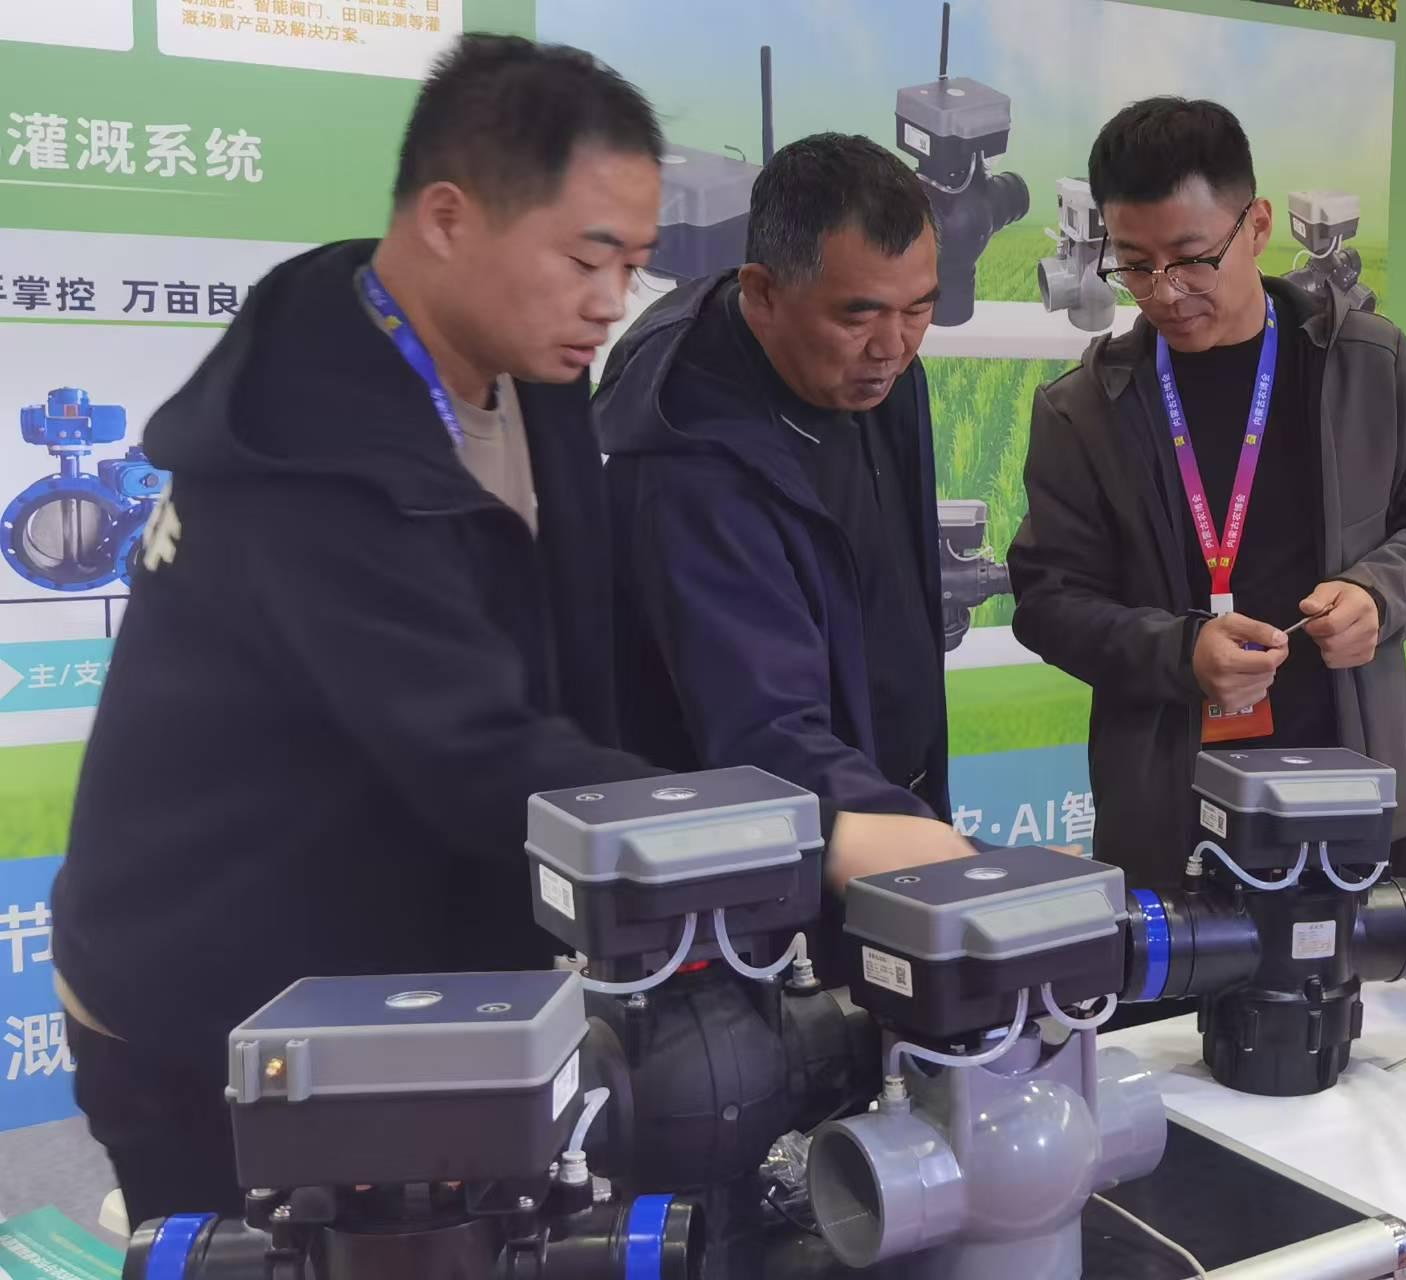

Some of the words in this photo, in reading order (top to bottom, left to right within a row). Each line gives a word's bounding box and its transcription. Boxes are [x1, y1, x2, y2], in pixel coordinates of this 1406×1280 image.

[7, 112, 264, 183] 灌溉系统
[0, 275, 96, 312] 掌控
[122, 280, 259, 316] 万亩良
[28, 660, 111, 689] 主/支
